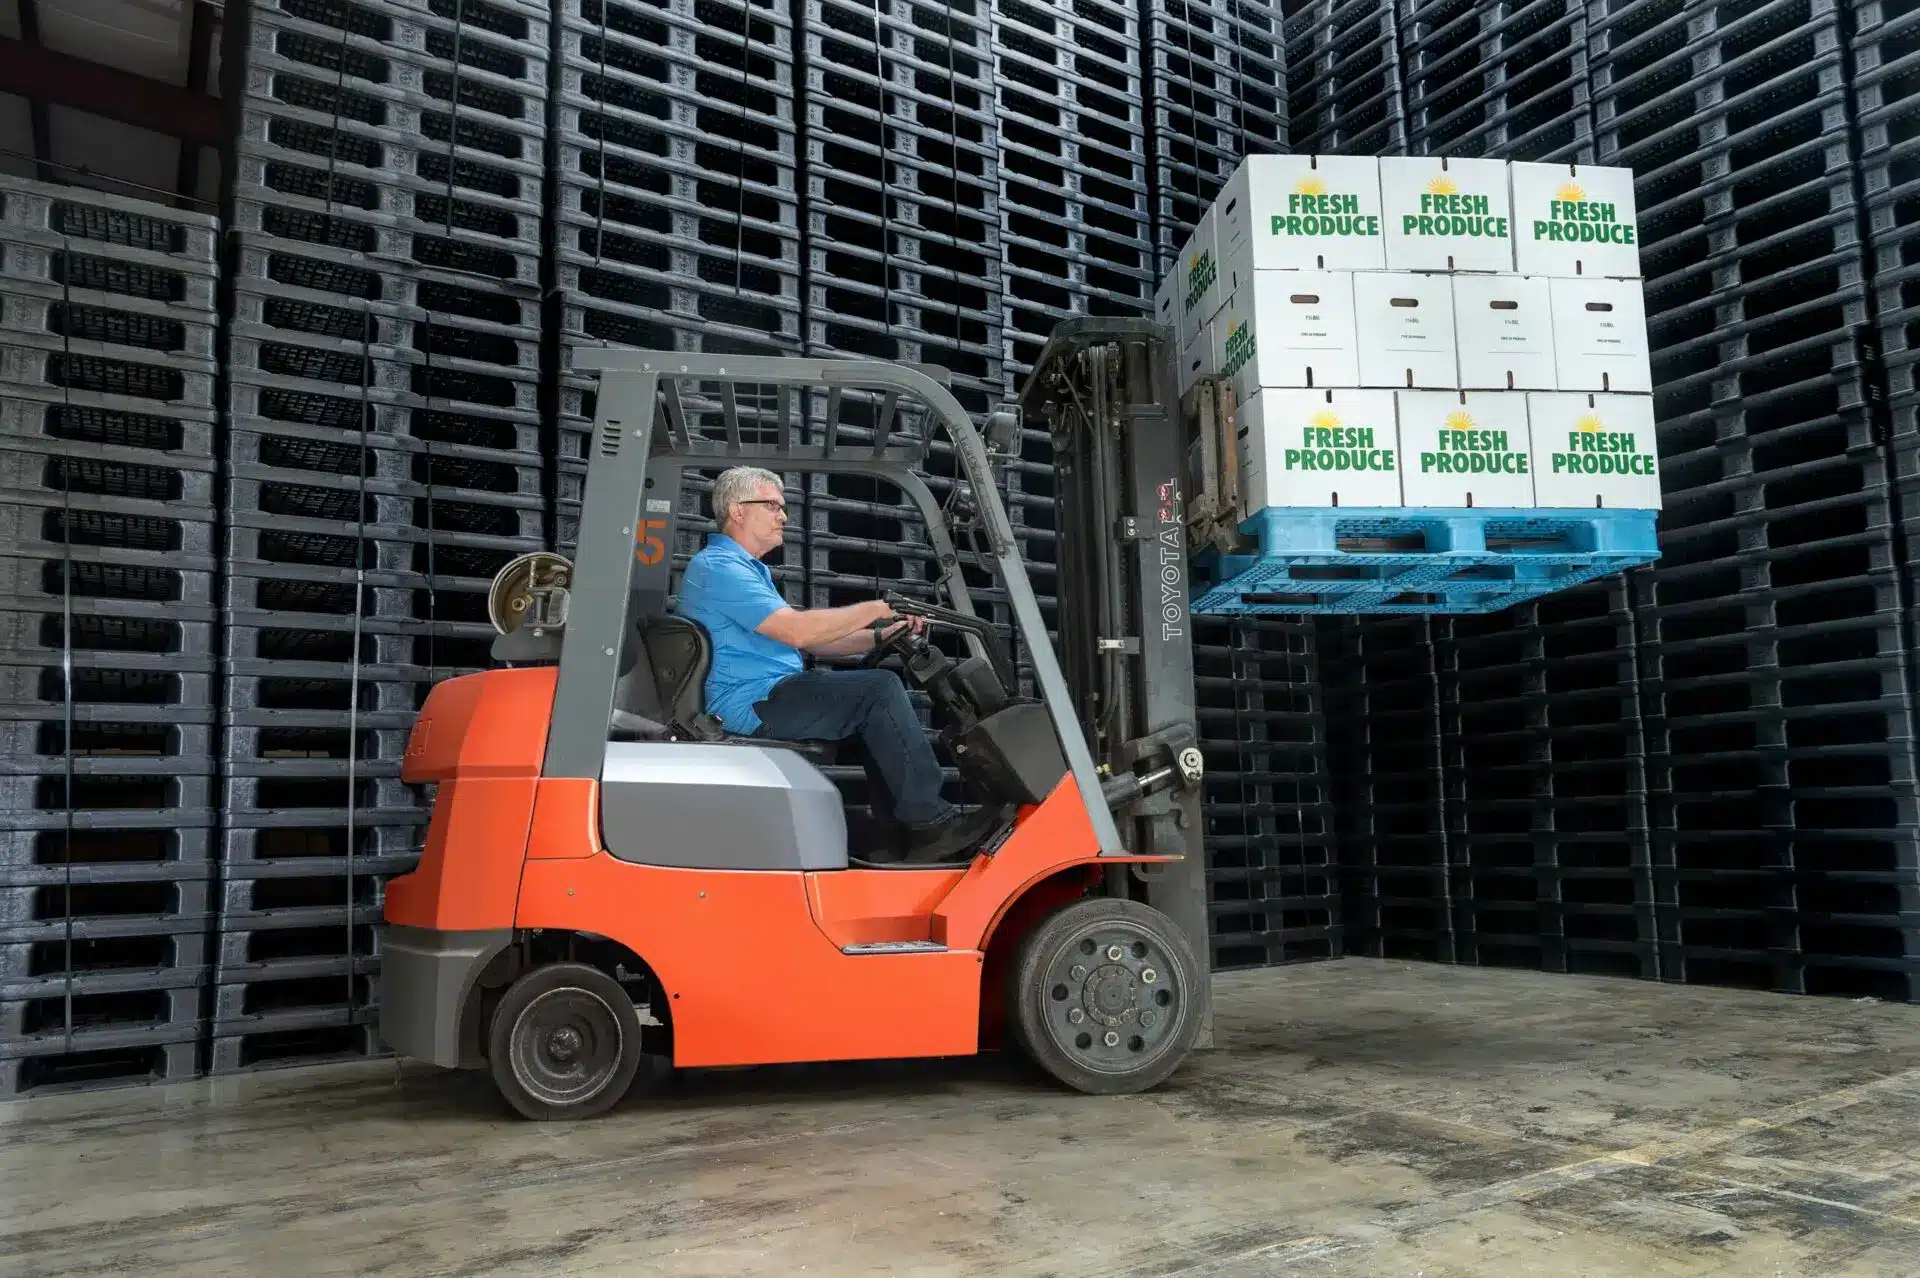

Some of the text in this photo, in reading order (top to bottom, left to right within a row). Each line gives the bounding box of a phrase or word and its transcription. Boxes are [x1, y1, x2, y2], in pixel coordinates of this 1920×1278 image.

[1288, 193, 1359, 215] FRESH
[1420, 193, 1489, 215] FRESH
[1550, 199, 1616, 223] FRESH
[1270, 215, 1379, 237] PRODUCE
[1402, 214, 1508, 238] PRODUCE
[1533, 220, 1634, 245] PRODUCE
[1188, 248, 1209, 291] FRESH
[1185, 260, 1217, 316] PRODUCE
[1225, 319, 1248, 361] FRESH
[1303, 426, 1375, 449] FRESH
[1438, 429, 1509, 452] FRESH
[1568, 431, 1636, 454] FRESH
[1284, 448, 1395, 472] PRODUCE
[1420, 451, 1529, 474] PRODUCE
[1551, 452, 1656, 476] PRODUCE
[634, 519, 667, 565] 5
[1160, 526, 1183, 641] TOYOTA
